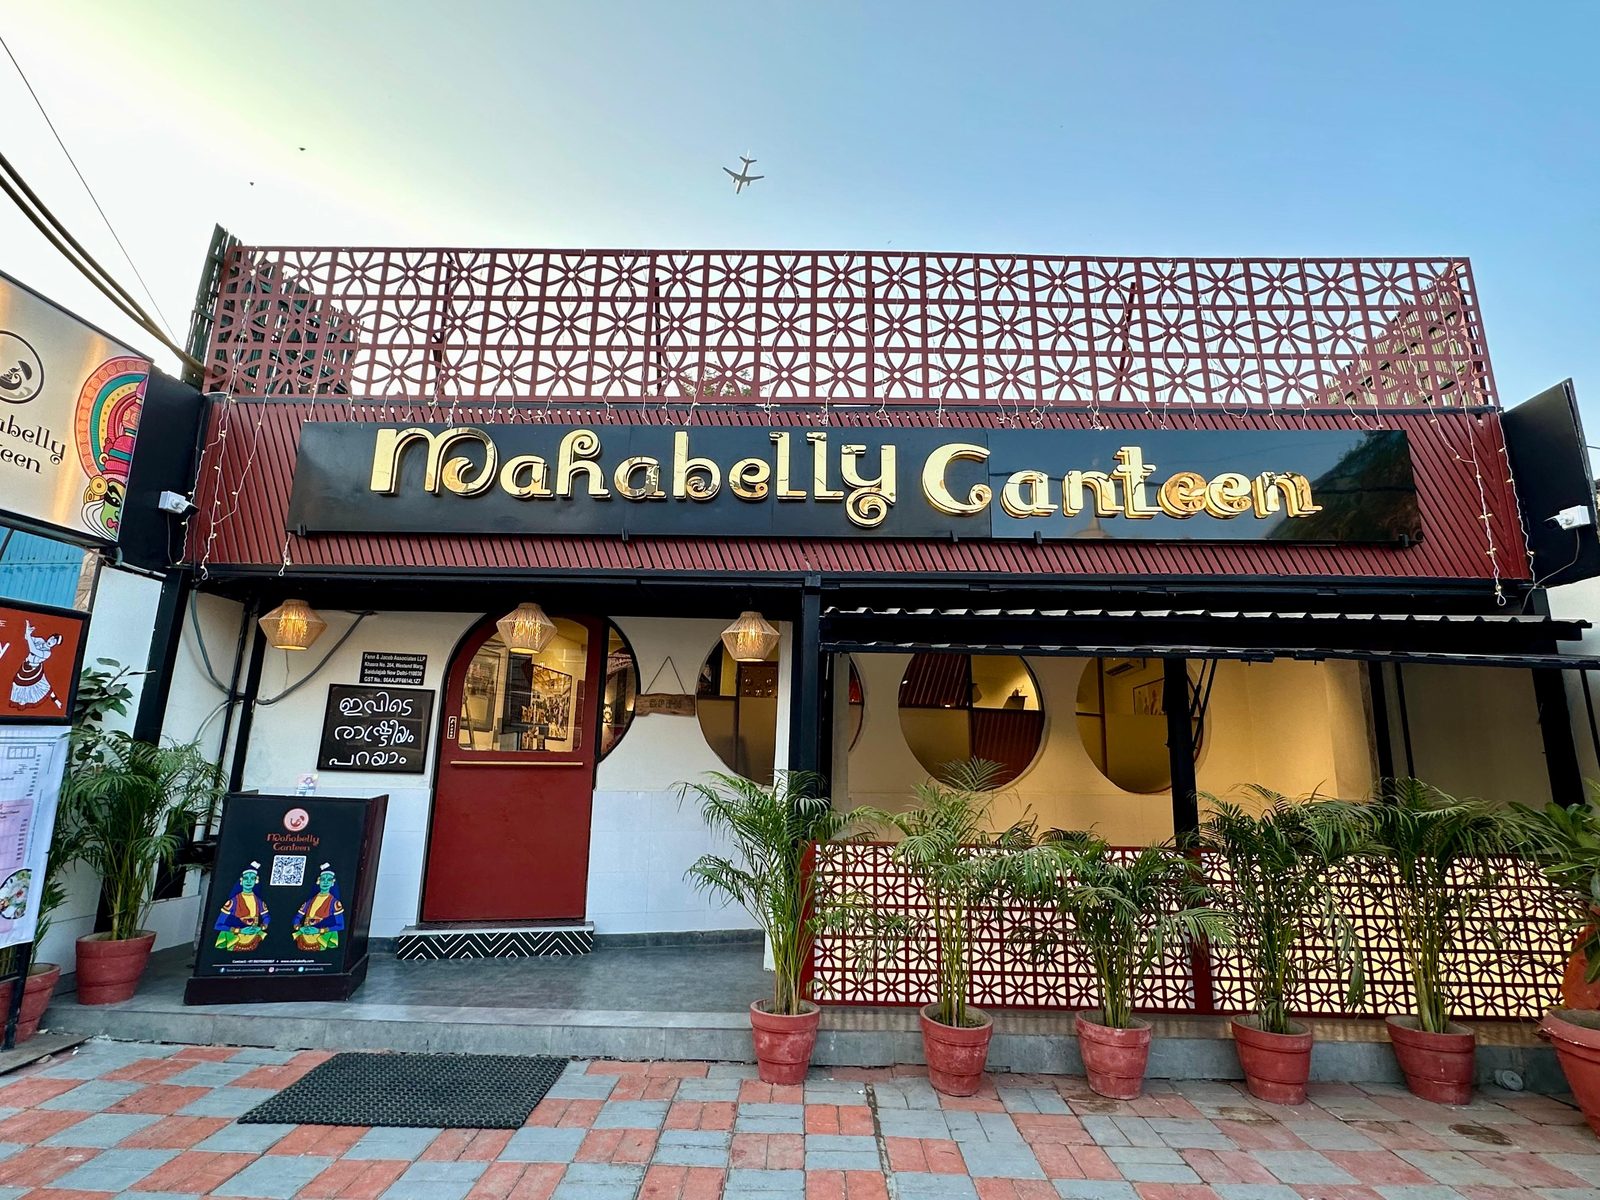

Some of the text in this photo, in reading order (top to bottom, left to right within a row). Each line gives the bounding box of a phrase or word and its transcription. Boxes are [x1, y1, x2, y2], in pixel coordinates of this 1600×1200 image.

[370, 427, 1323, 528] Mahabelly Canteen
[340, 691, 414, 716] ഇവിടെ
[328, 751, 407, 767] പറയാം
[267, 833, 320, 847] Mahabelly
[273, 842, 310, 851] Canteen
